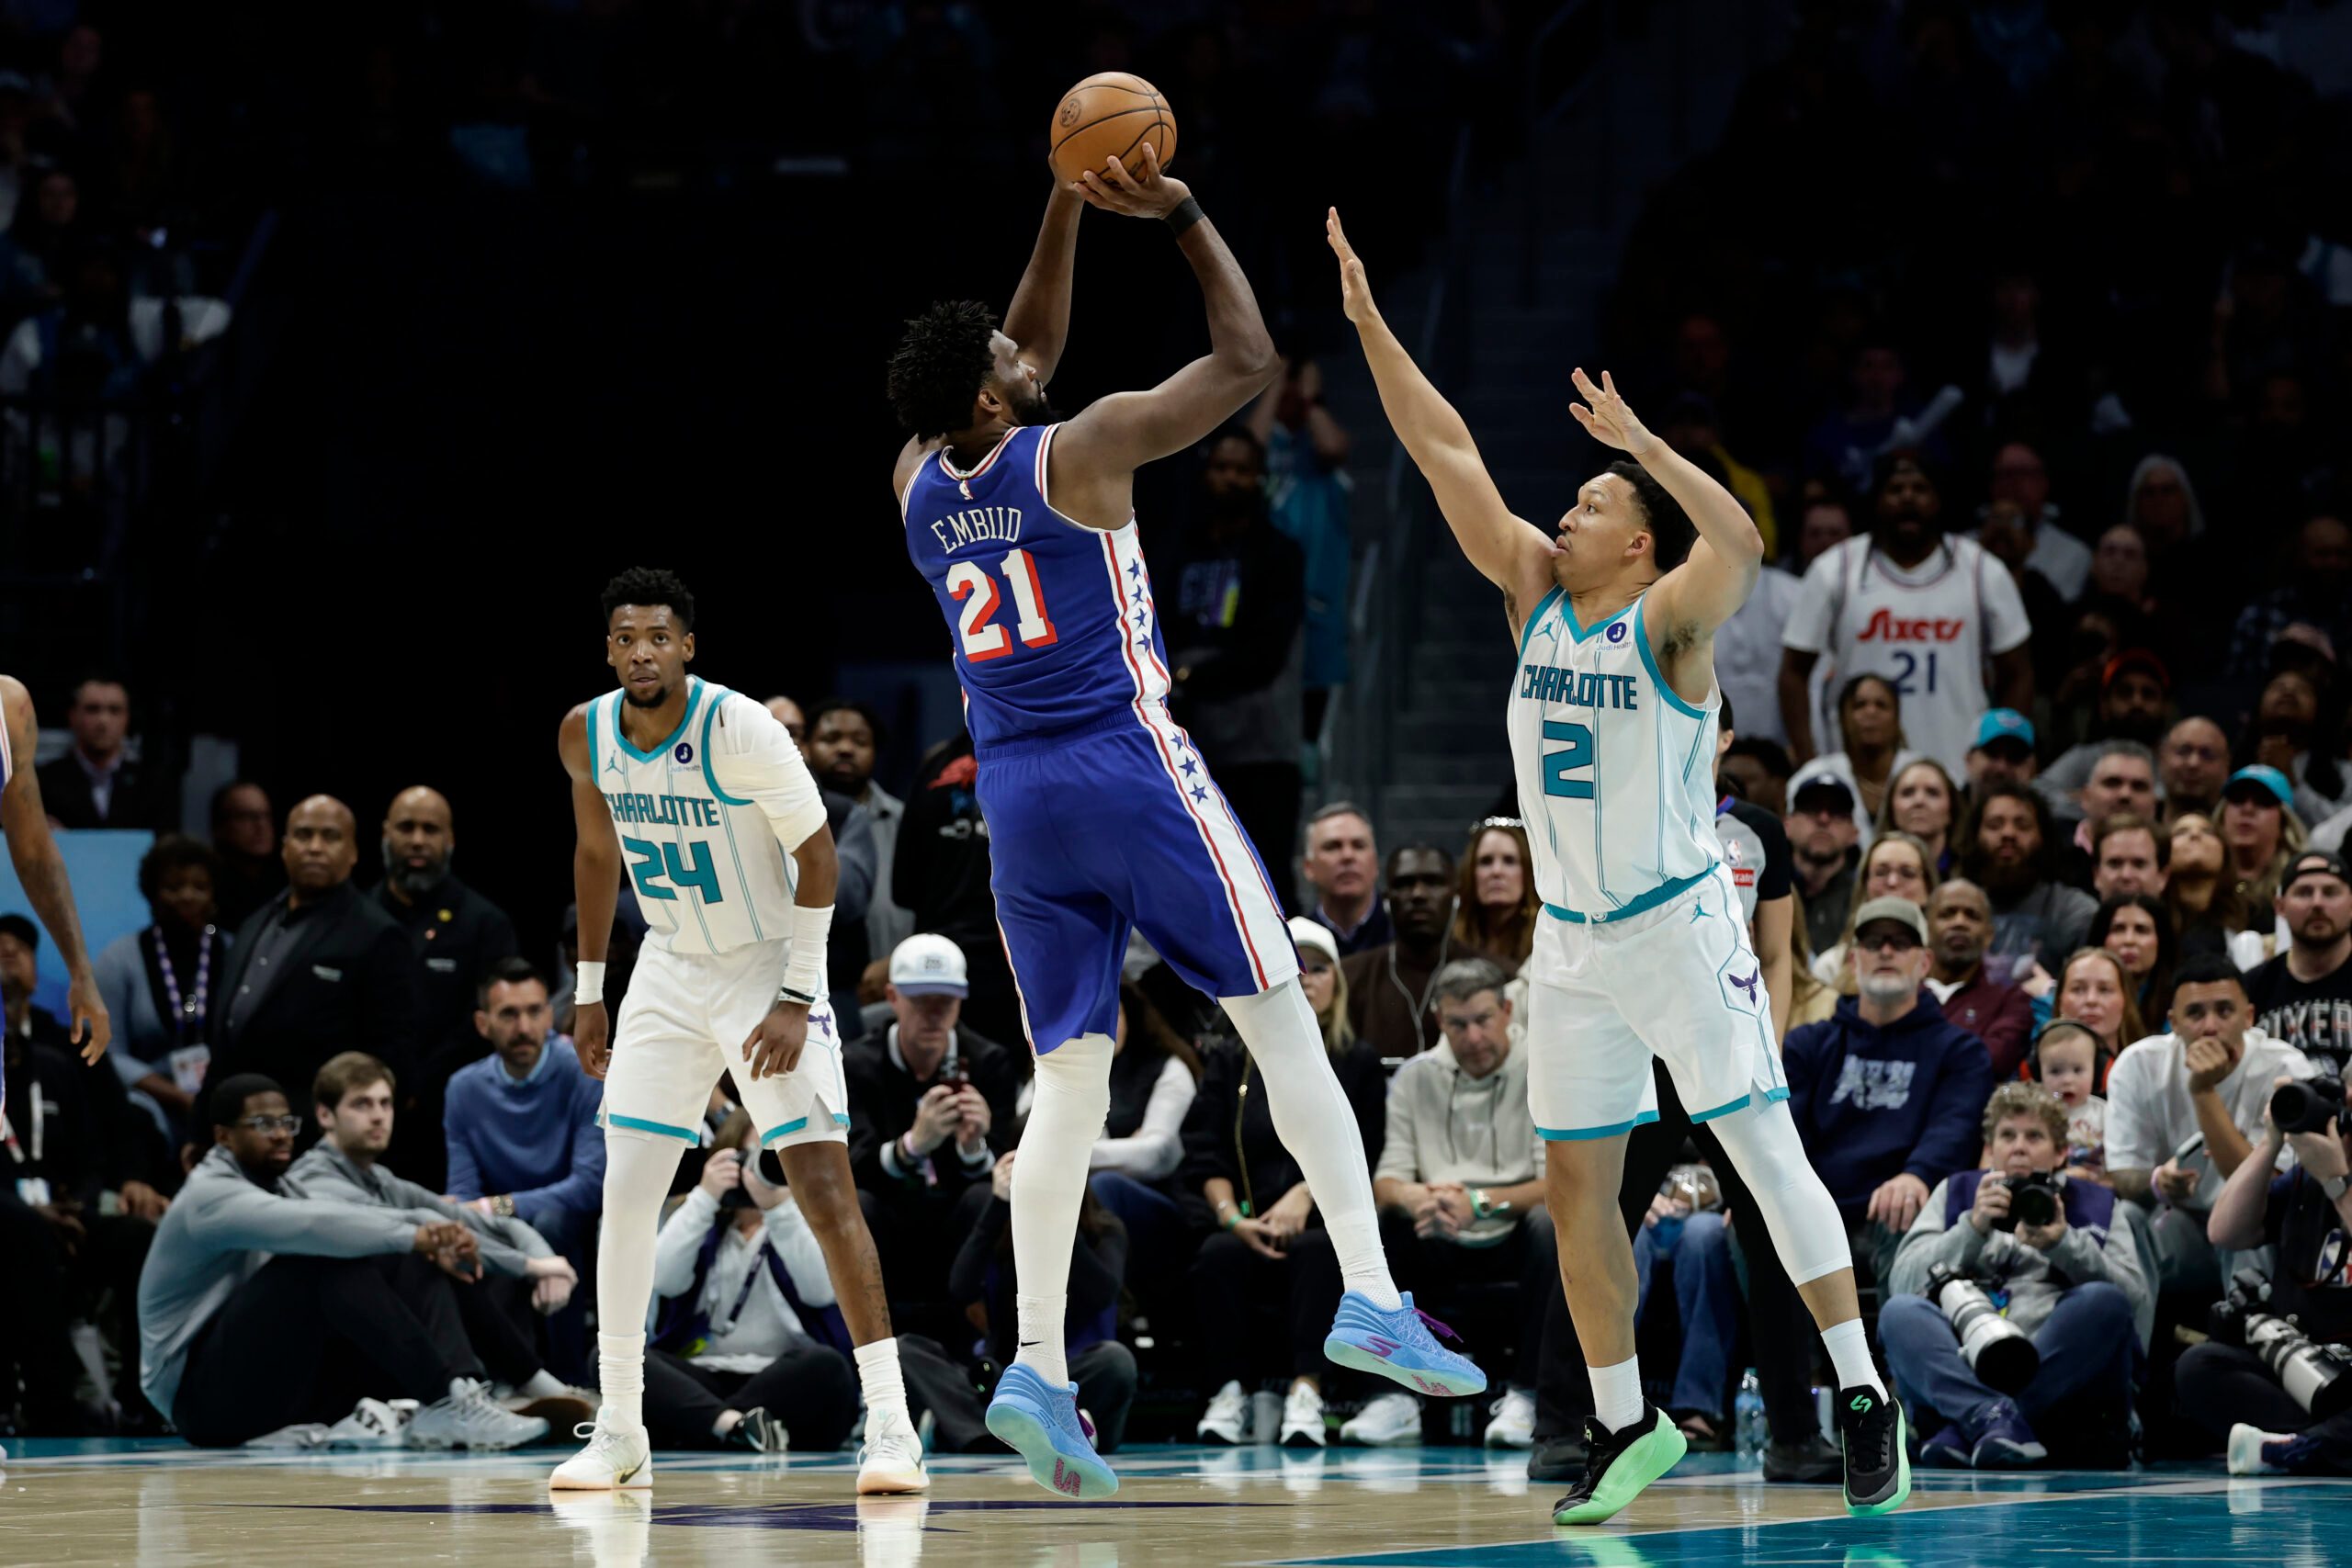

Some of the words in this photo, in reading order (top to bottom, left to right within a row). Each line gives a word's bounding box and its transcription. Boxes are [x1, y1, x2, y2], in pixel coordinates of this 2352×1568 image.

[931, 506, 1023, 554] EMBIID
[945, 548, 1059, 663] 21
[1613, 641, 1633, 651] Health
[1520, 664, 1638, 710] CHARLOTTE
[1891, 650, 1936, 693] 21
[1544, 720, 1594, 799] 2
[622, 834, 724, 905] 24
